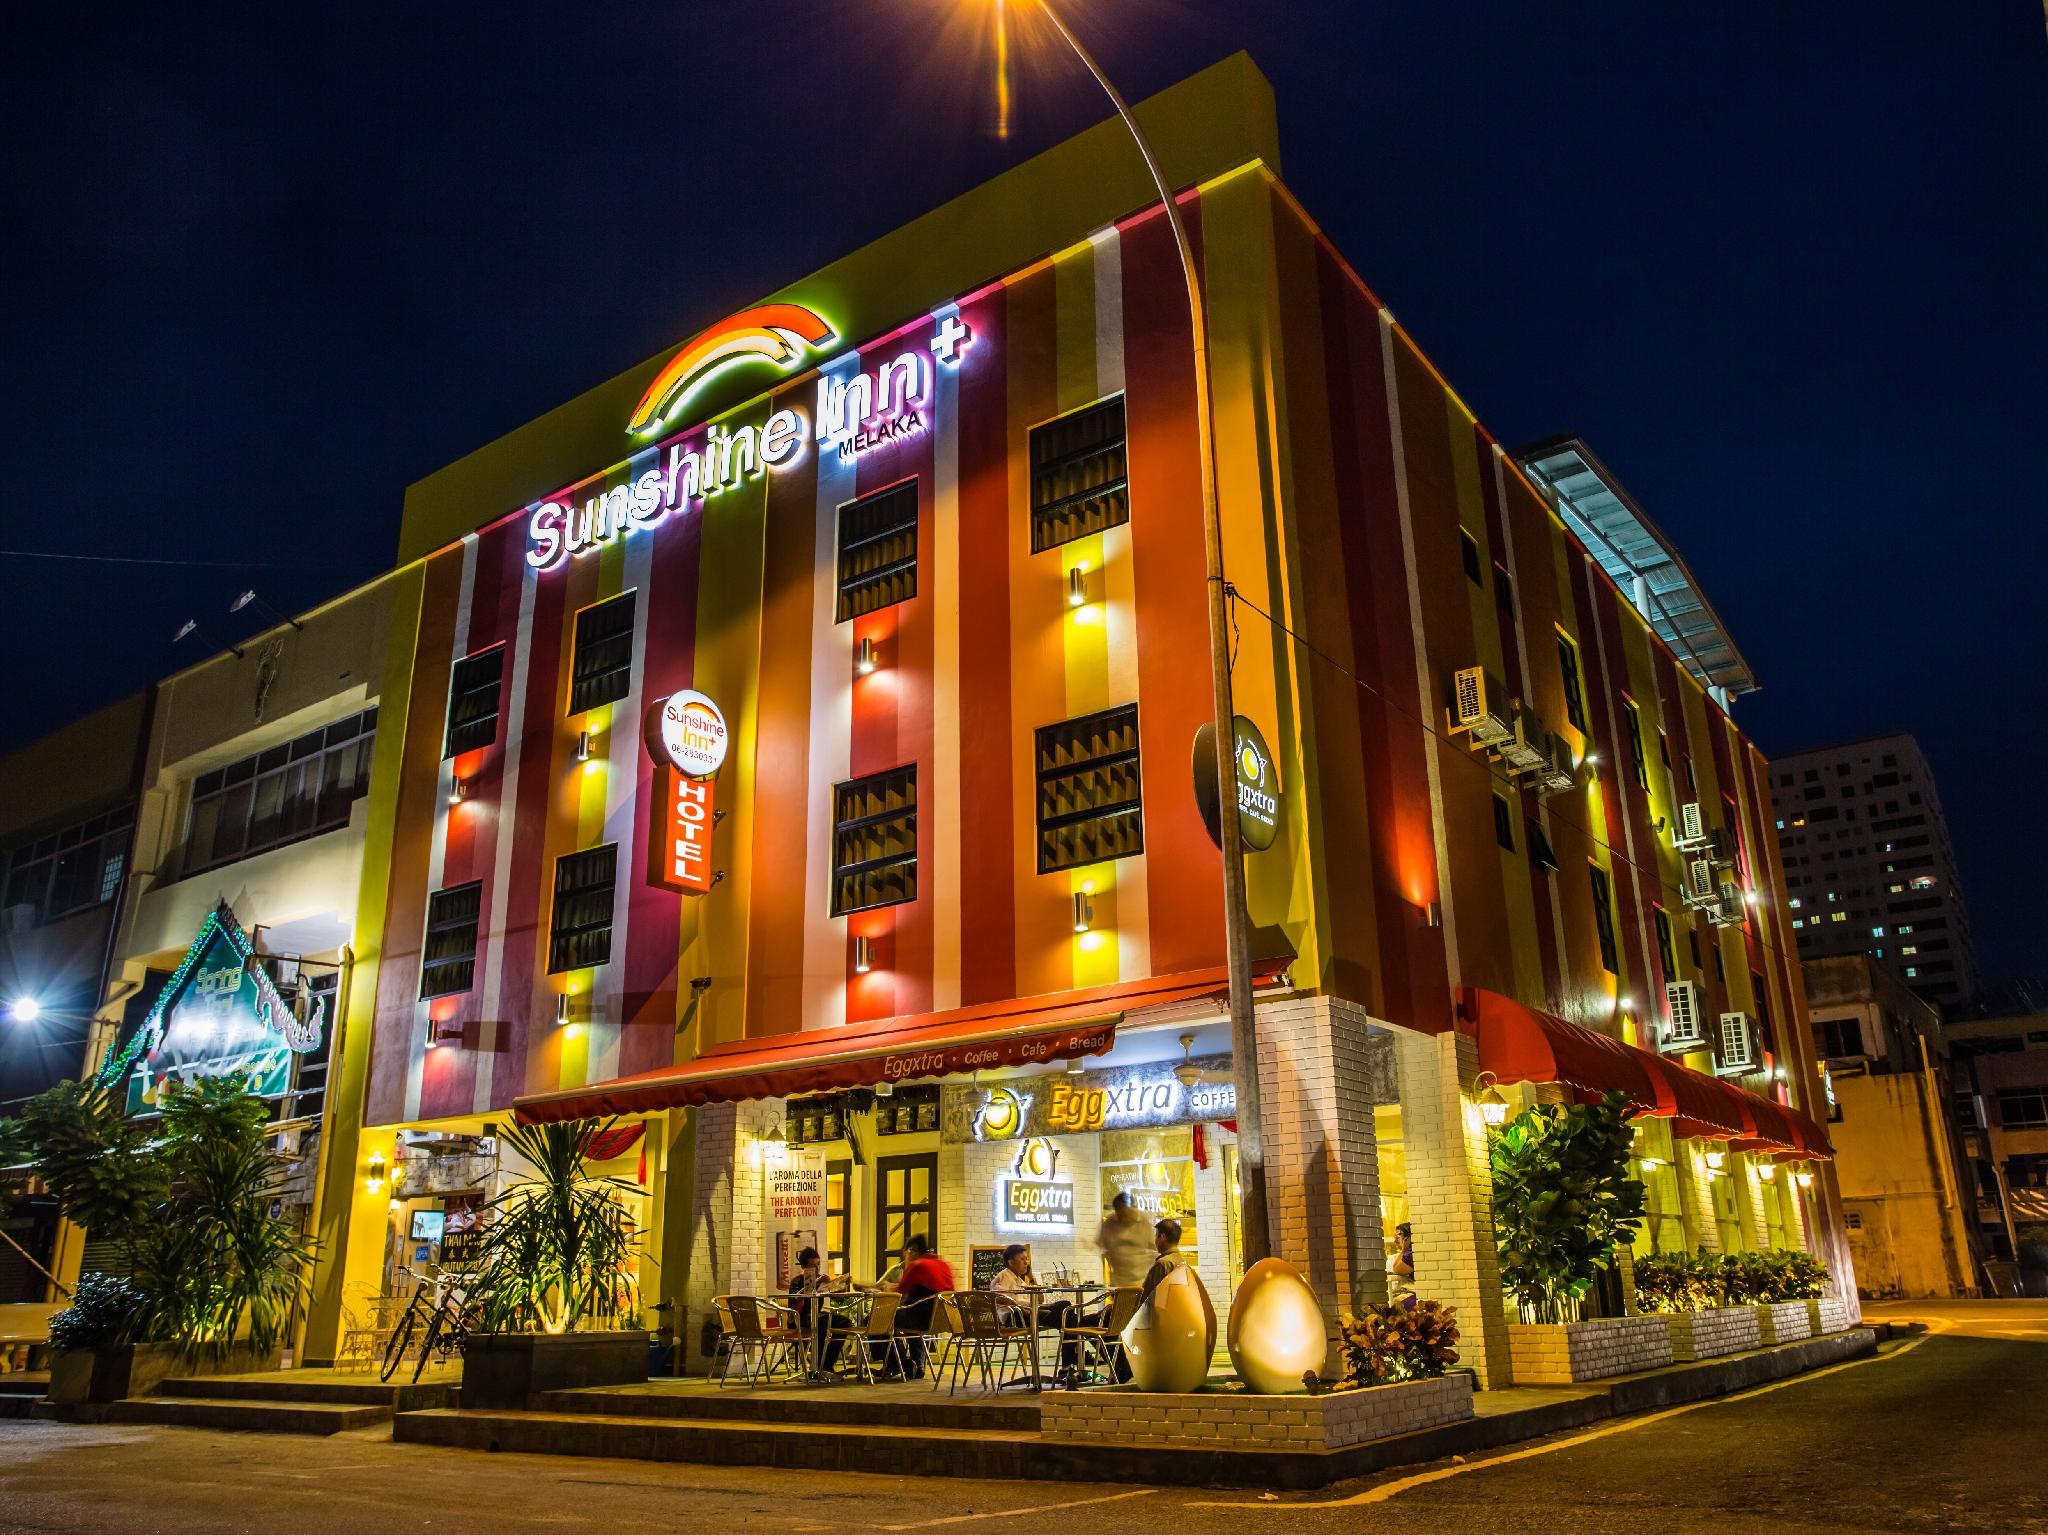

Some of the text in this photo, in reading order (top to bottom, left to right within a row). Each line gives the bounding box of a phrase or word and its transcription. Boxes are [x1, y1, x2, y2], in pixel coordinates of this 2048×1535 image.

[838, 409, 923, 460] MELAKA
[526, 408, 803, 571] Sunshine
[667, 706, 724, 737] Sunshine
[1238, 781, 1275, 814] ggxtra
[674, 780, 706, 882] HOTEL
[884, 1033, 1105, 1077] Eggxtra Coffee Cafe Bread
[1048, 1081, 1236, 1125] Eggxtra COFFE
[774, 1181, 817, 1192] PERFEZIONE
[801, 1169, 822, 1180] DELLA
[771, 1195, 822, 1207] THE AROMA OF
[774, 1206, 817, 1218] PERFECTION
[1011, 1182, 1072, 1213] Eggxtra
